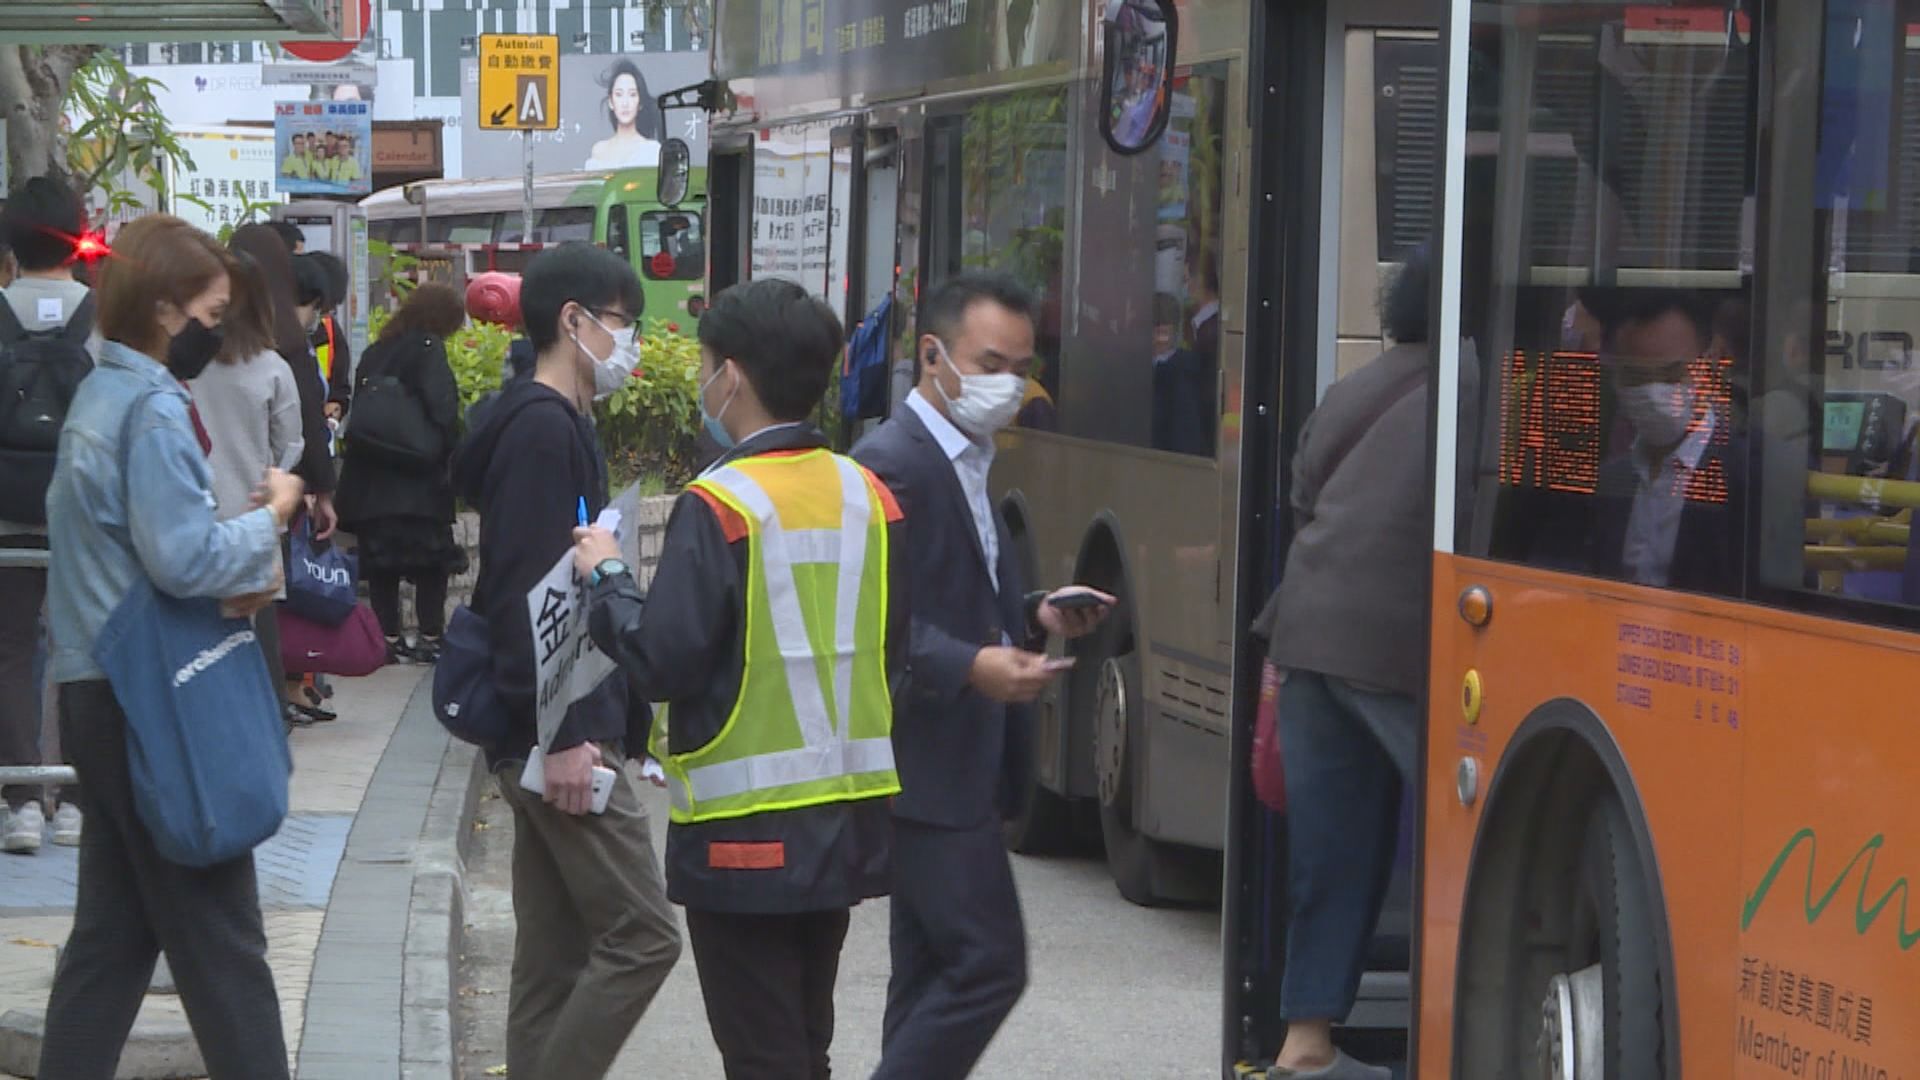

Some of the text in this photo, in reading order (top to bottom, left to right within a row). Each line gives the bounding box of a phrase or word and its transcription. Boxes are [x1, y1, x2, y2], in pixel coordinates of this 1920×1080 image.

[495, 39, 544, 49] Autotoll
[1738, 957, 1873, 1046] 新創建集團成員
[1736, 1015, 1811, 1080] Member
[1814, 1049, 1836, 1080] of
